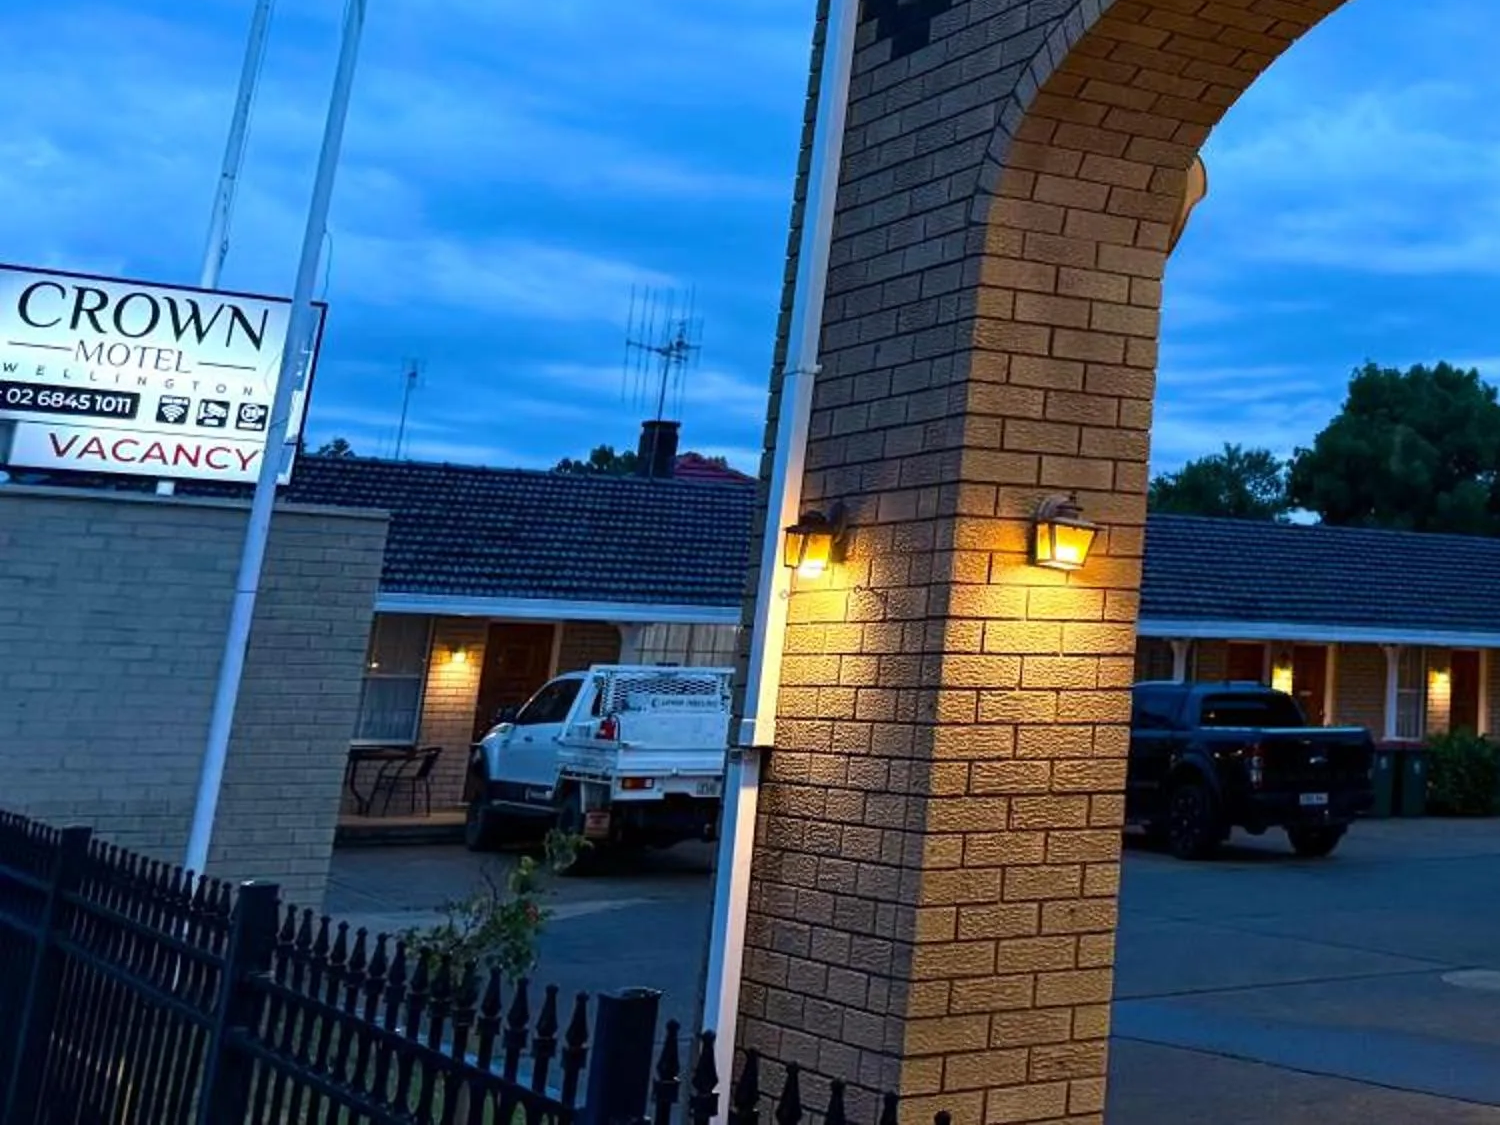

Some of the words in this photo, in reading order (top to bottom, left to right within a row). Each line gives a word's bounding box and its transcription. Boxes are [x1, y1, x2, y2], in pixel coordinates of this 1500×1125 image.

[17, 280, 269, 351] CROWN
[74, 339, 192, 374] MOTEL
[3, 361, 254, 396] WELLINGTON
[6, 388, 34, 406] 02
[37, 390, 92, 410] 6845
[95, 394, 131, 413] 1011
[49, 432, 260, 472] VACANCY
